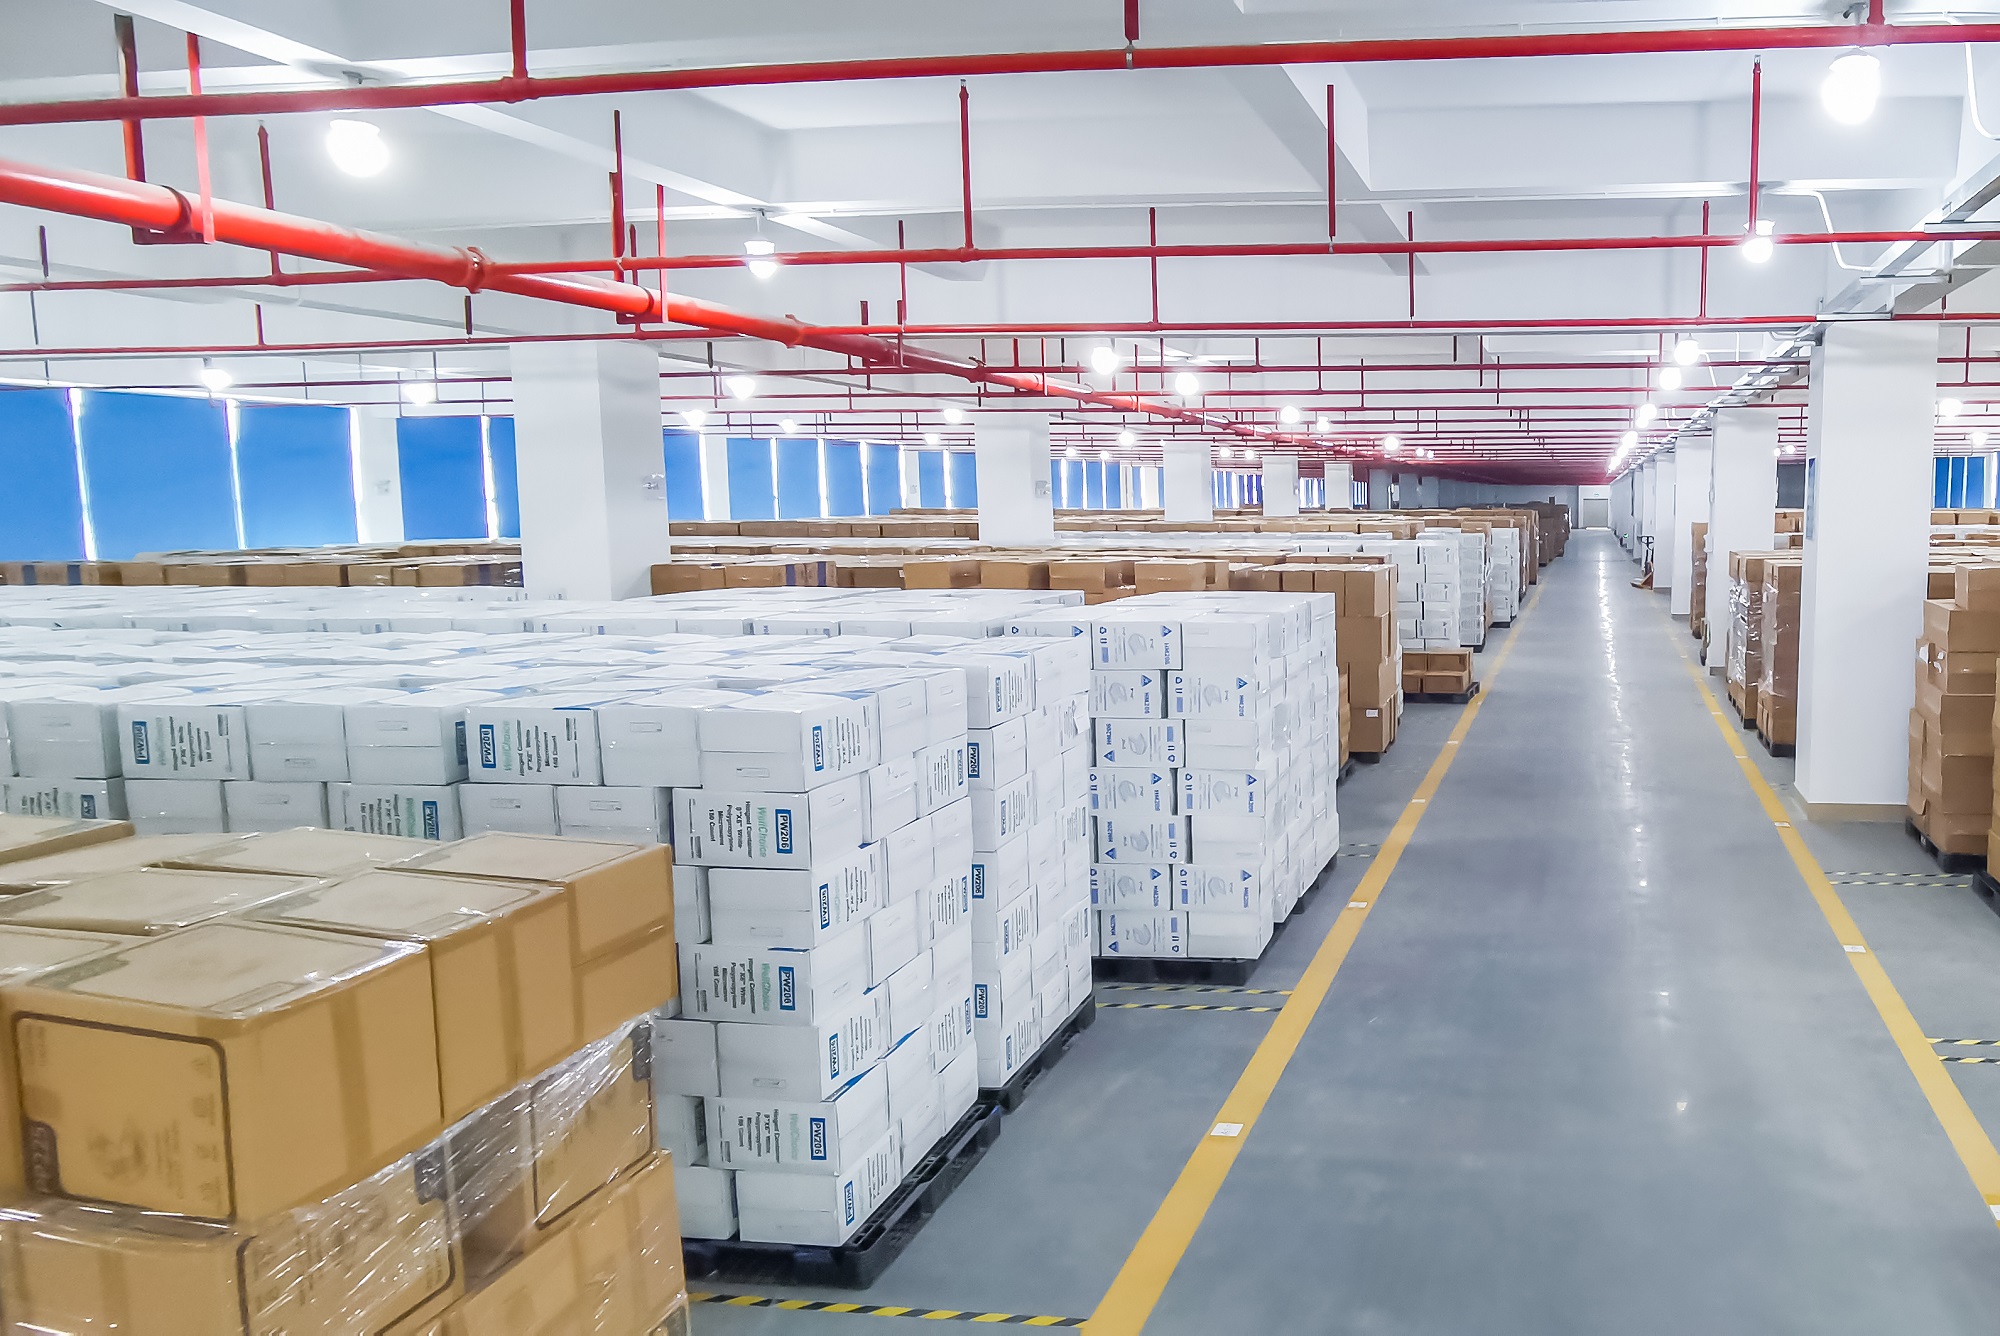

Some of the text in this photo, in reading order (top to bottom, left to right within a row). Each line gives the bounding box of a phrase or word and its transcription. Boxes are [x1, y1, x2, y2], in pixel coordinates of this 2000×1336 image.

[969, 747, 978, 773] PW206
[757, 807, 768, 858] WellChoice
[779, 815, 790, 849] PW206
[974, 868, 982, 893] PW206
[813, 1122, 823, 1155] PW206
